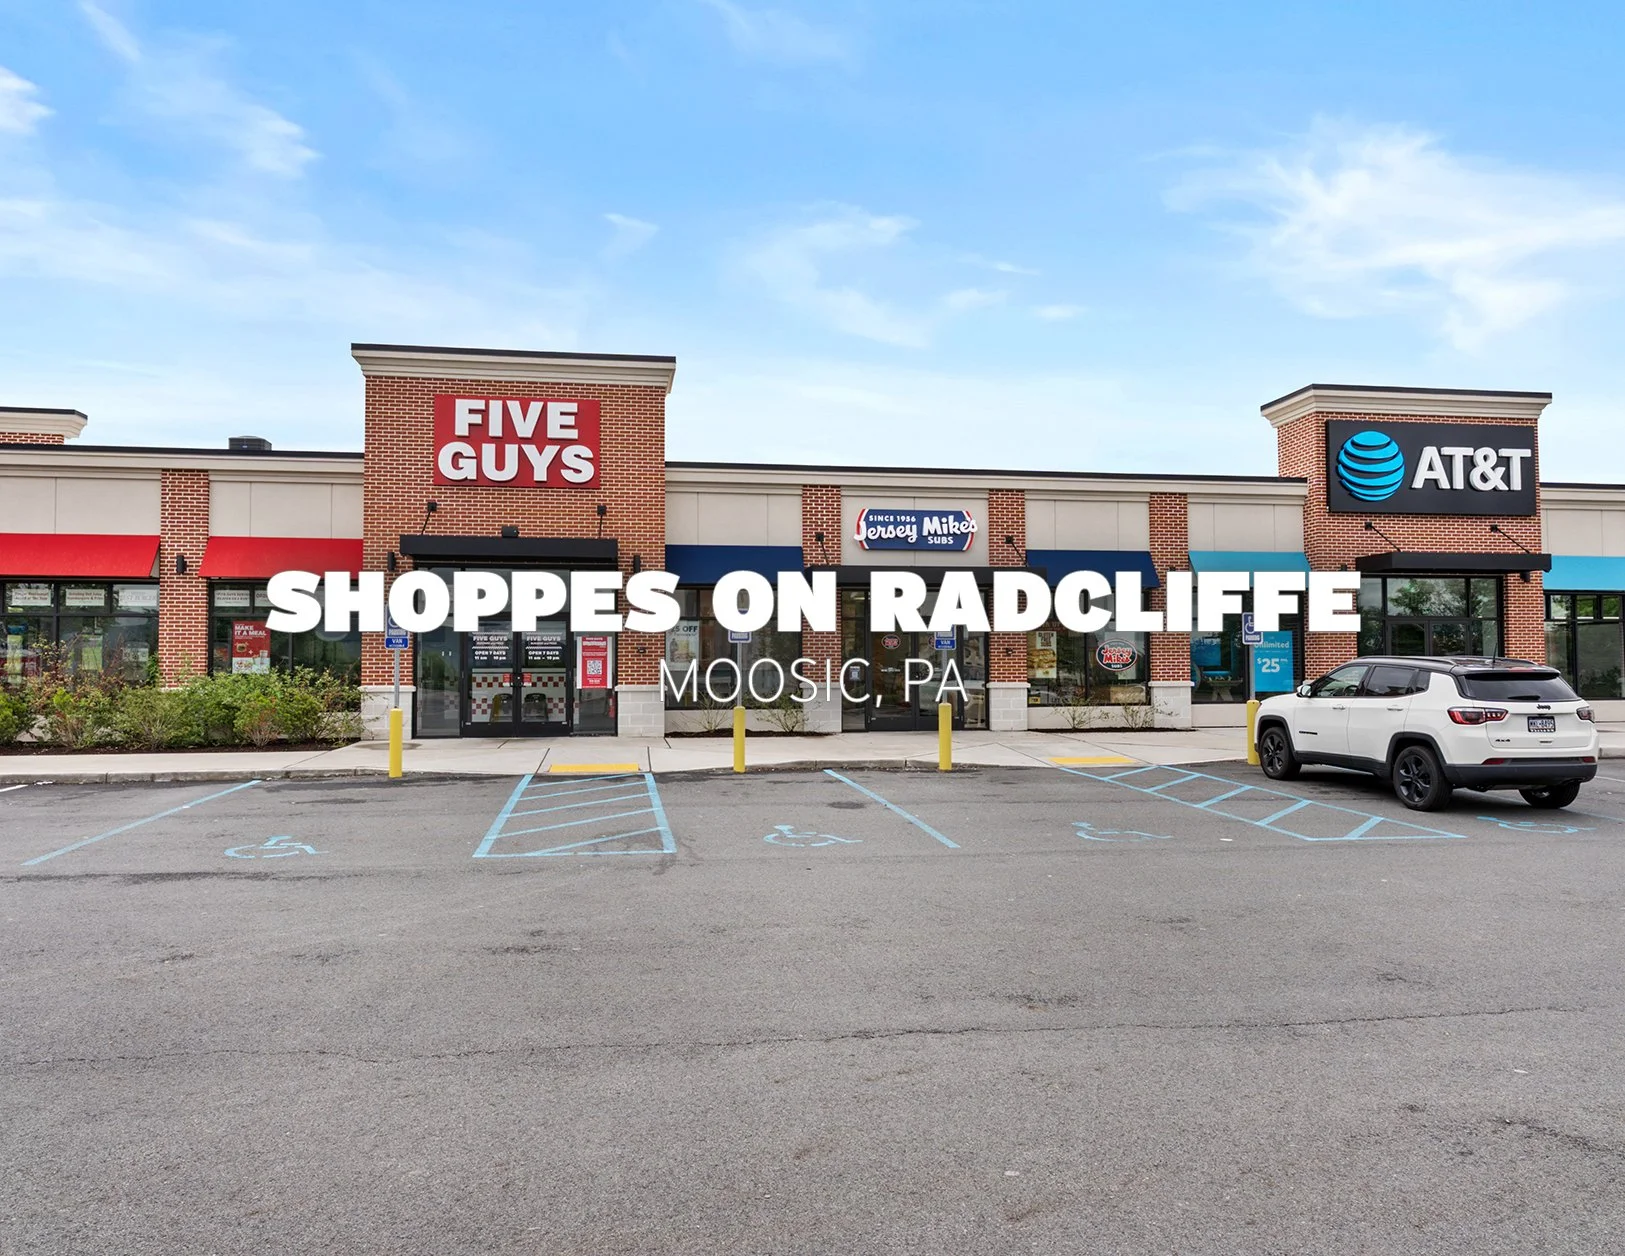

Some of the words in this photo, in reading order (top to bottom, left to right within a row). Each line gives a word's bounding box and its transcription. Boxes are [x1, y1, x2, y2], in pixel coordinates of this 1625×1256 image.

[454, 398, 579, 439] FIVE
[437, 441, 595, 484] GUYS
[1411, 446, 1532, 491] AT&T
[854, 520, 918, 543] Jersey
[927, 536, 954, 544] SUBS
[1101, 645, 1133, 657] Jersey
[1256, 658, 1281, 673] $25
